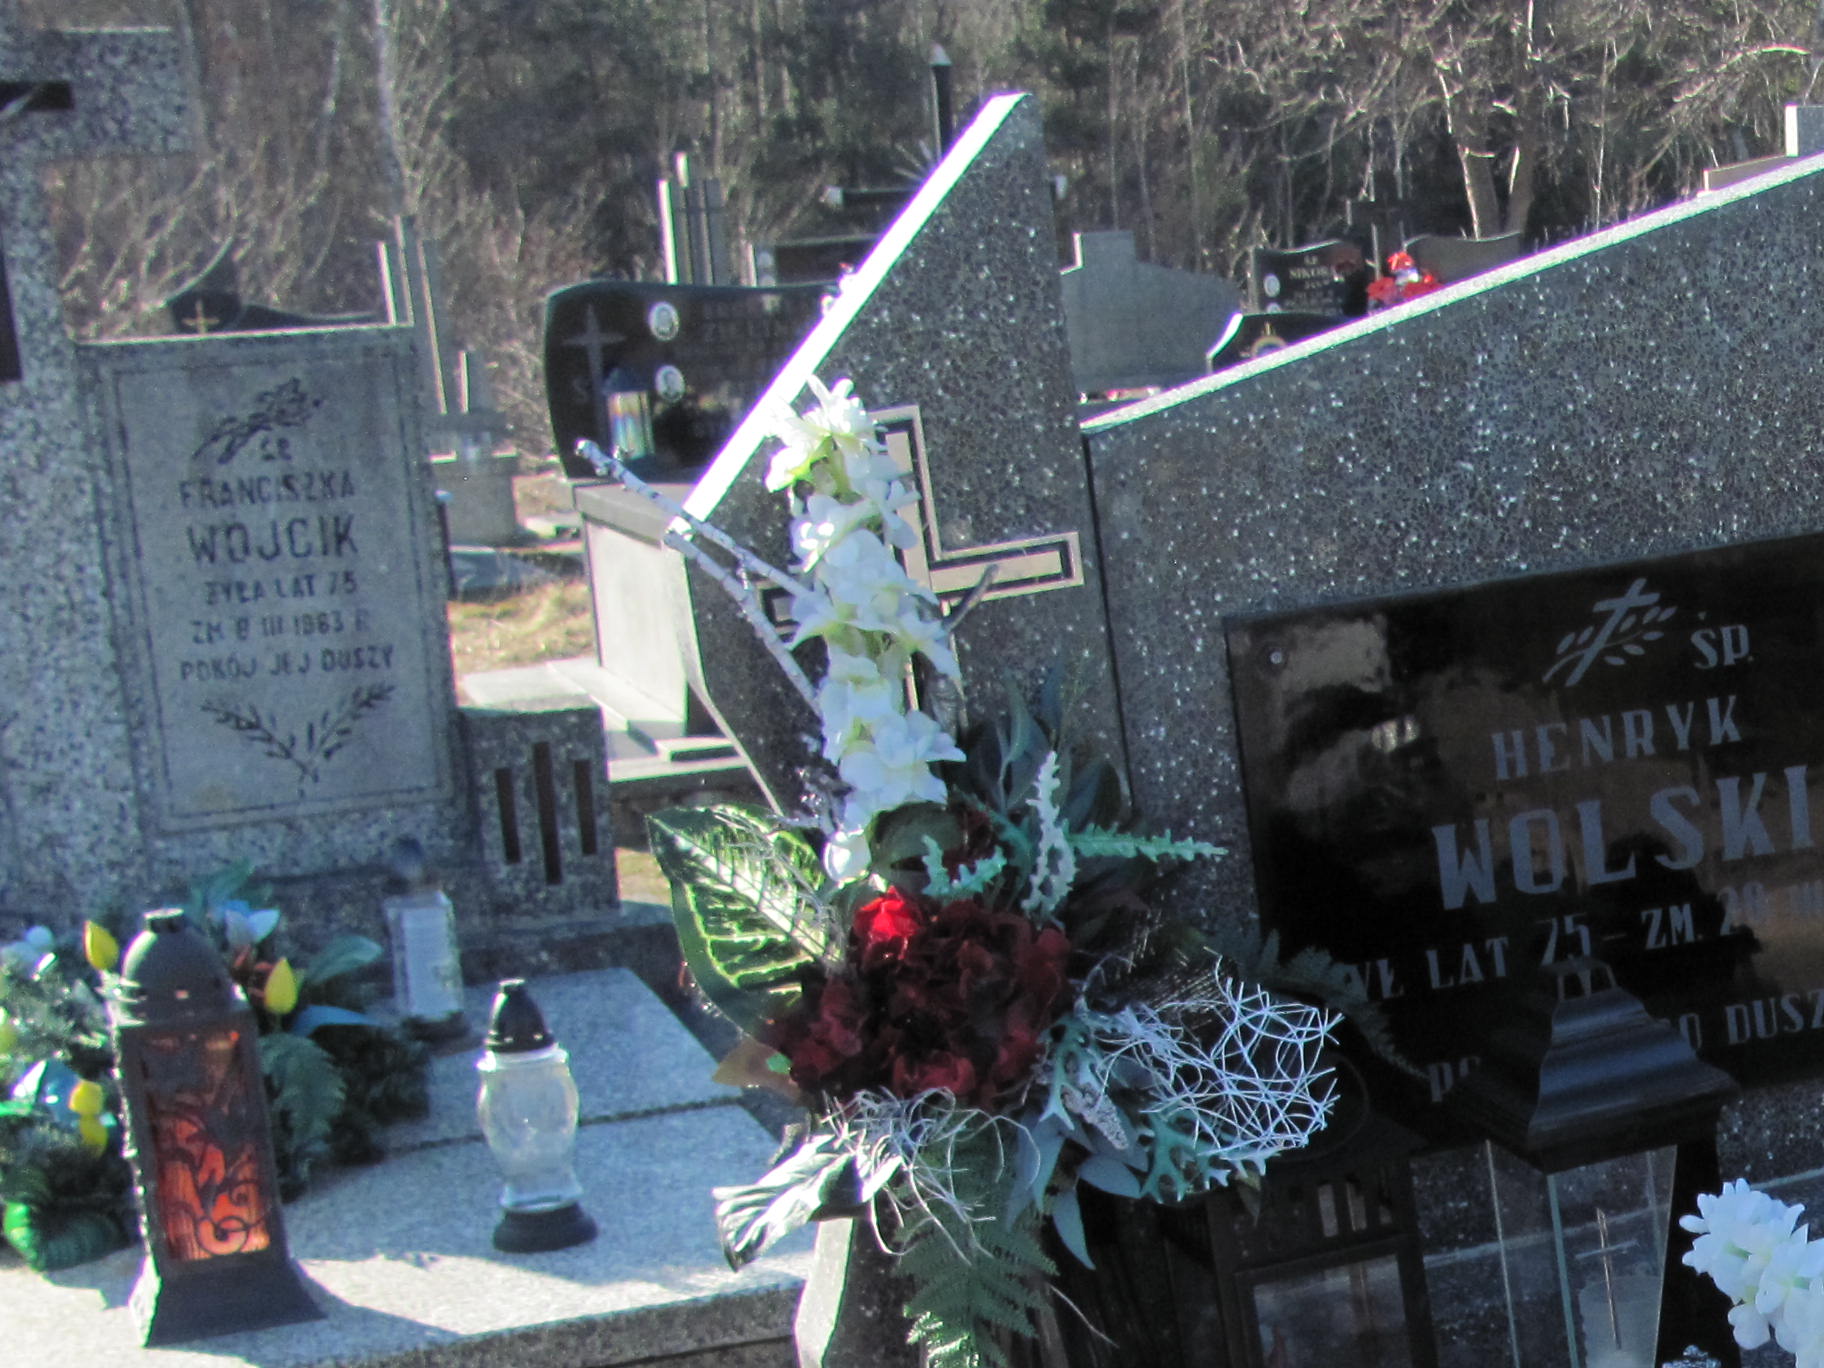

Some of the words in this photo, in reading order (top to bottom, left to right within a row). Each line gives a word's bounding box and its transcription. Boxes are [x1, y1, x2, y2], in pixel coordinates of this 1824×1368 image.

[179, 469, 356, 508] FRANCISZKA
[275, 574, 316, 599] LAT
[329, 570, 358, 596] 75
[270, 651, 310, 676] JEJ
[321, 644, 393, 672] DUSZY
[1491, 695, 1742, 780] HENRYK
[1432, 764, 1815, 910] WOLSKI
[1426, 936, 1509, 989] LAT
[1541, 913, 1591, 966] 75
